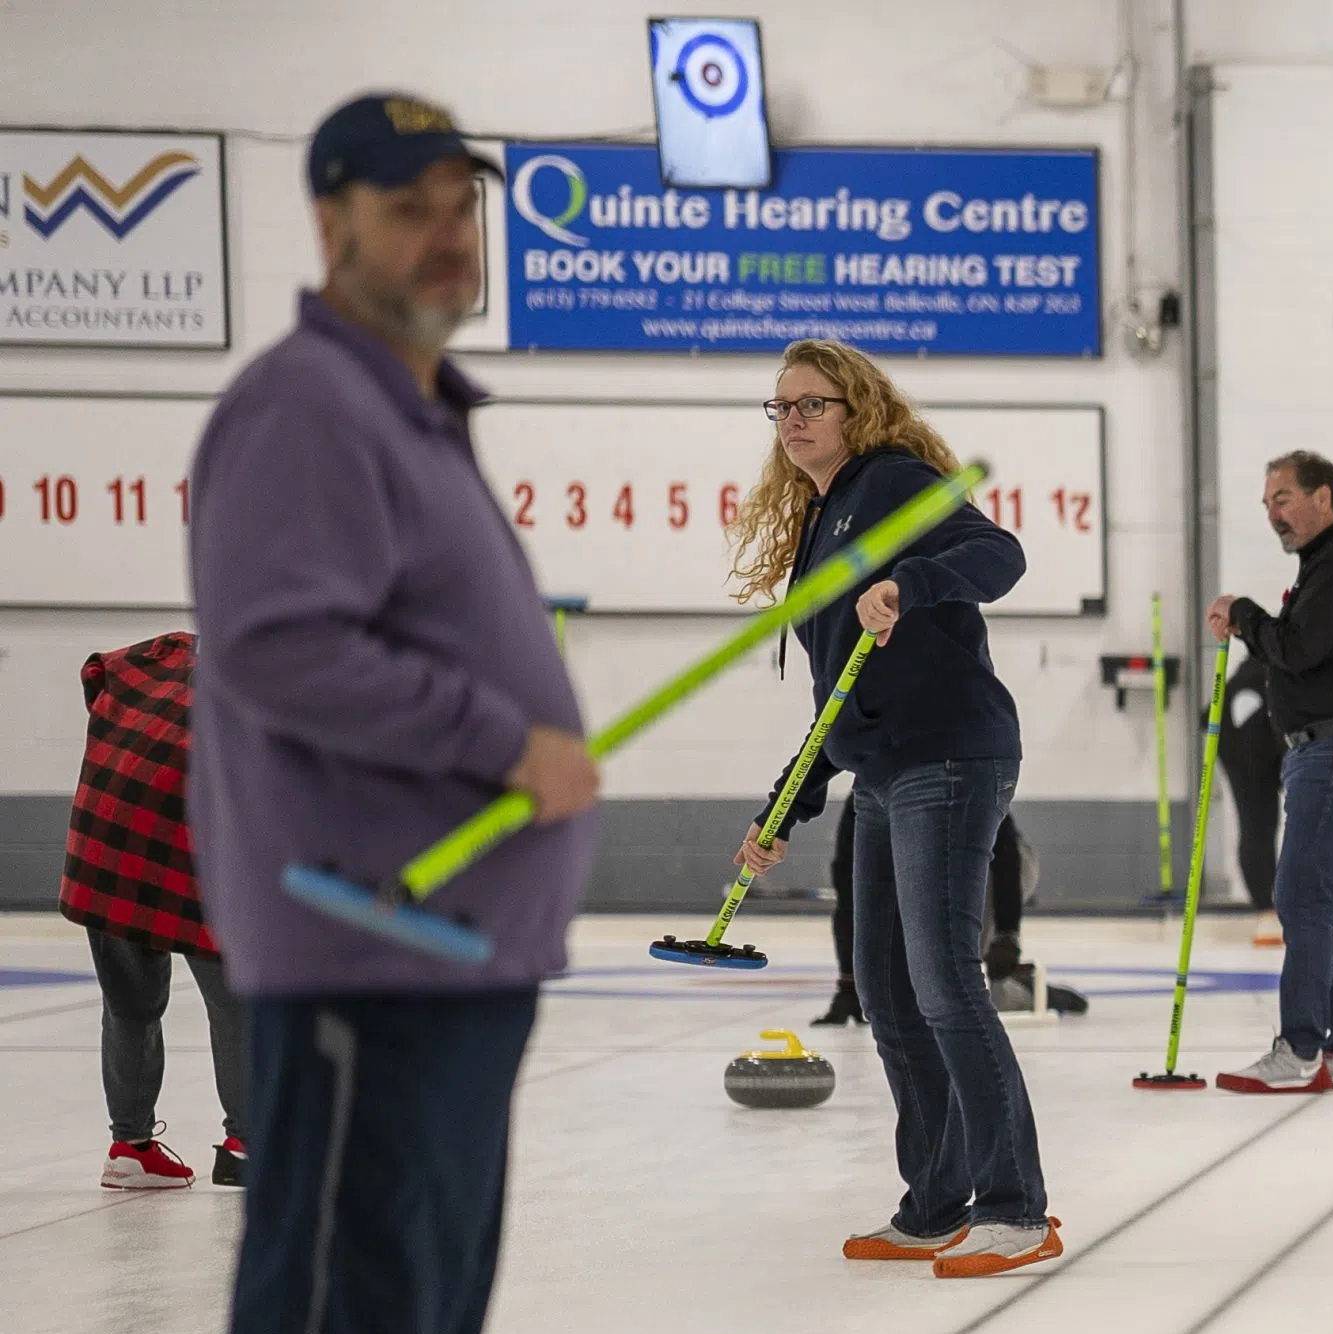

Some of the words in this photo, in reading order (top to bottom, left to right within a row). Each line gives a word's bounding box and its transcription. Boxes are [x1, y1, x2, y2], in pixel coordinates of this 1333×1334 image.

[512, 154, 710, 248] Quinte
[723, 187, 912, 240] Hearing
[922, 190, 1088, 233] Centre
[141, 268, 203, 300] LLP
[523, 250, 626, 283] BOOK
[634, 251, 730, 284] YOUR
[738, 254, 826, 284] FREE
[834, 254, 988, 287] HEARING
[994, 254, 1081, 288] TEST
[6, 303, 204, 329] ACCOUNTANTS
[33, 476, 78, 524] 10
[106, 476, 146, 524] 11
[513, 481, 536, 529] 2
[565, 481, 588, 530] 3
[612, 482, 634, 530] 4
[667, 483, 690, 531] 5
[719, 483, 740, 529] 6
[985, 485, 1024, 531] 11
[762, 809, 785, 847] ROPERTY
[786, 780, 801, 797] THE
[721, 898, 741, 923] ASHAM
